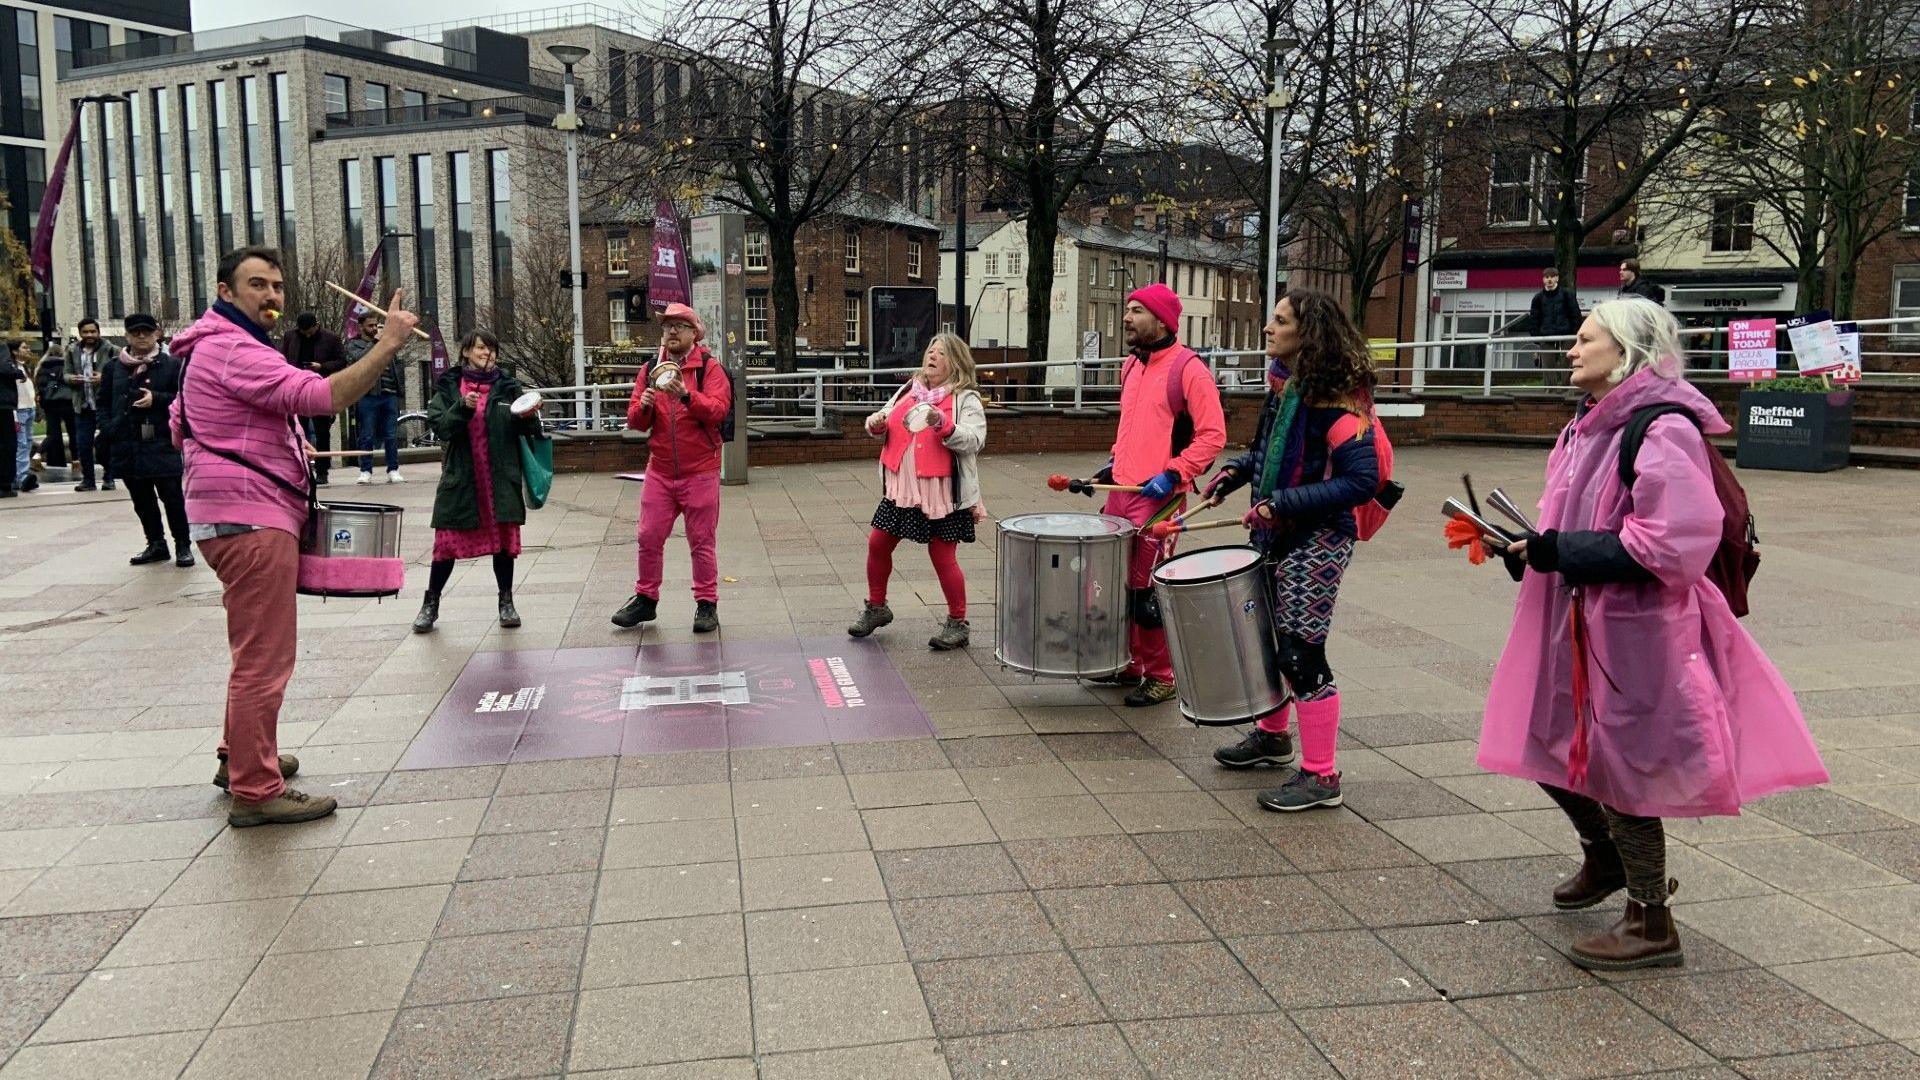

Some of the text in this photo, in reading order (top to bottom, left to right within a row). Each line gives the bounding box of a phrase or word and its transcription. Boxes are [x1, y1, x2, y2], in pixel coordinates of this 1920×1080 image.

[1787, 316, 1806, 327] UCU
[1733, 322, 1749, 331] ON
[1733, 330, 1771, 339] STRIKE
[1733, 340, 1769, 349] TODAY
[1734, 351, 1755, 359] UCU
[1734, 359, 1769, 368] PROUD
[1749, 406, 1805, 417] Sheffield
[1748, 416, 1793, 427] Hallam
